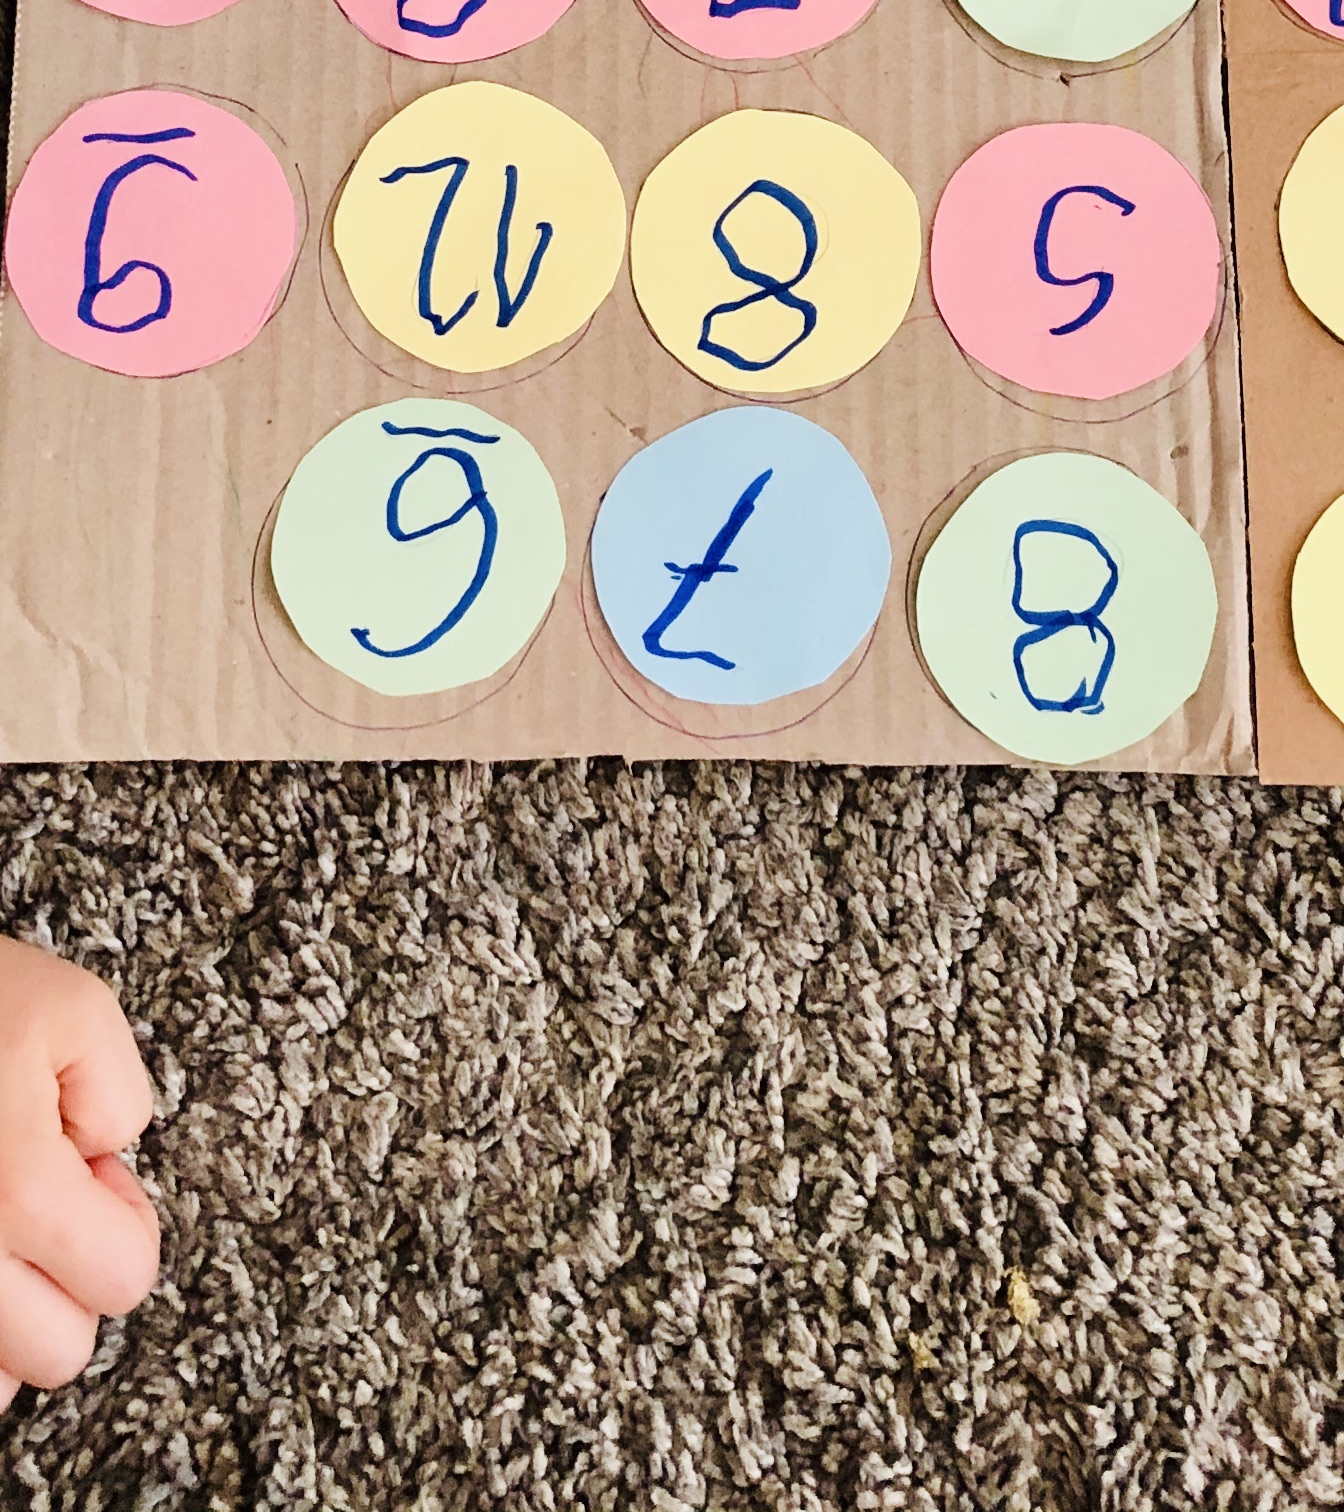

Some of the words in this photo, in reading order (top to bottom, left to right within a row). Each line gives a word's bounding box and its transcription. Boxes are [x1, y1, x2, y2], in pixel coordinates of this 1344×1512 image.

[380, 157, 554, 336] 12
[698, 180, 818, 371] 8
[1034, 186, 1136, 335] 5
[351, 421, 499, 658] 6
[642, 469, 774, 671] 7
[1011, 519, 1120, 716] 8
